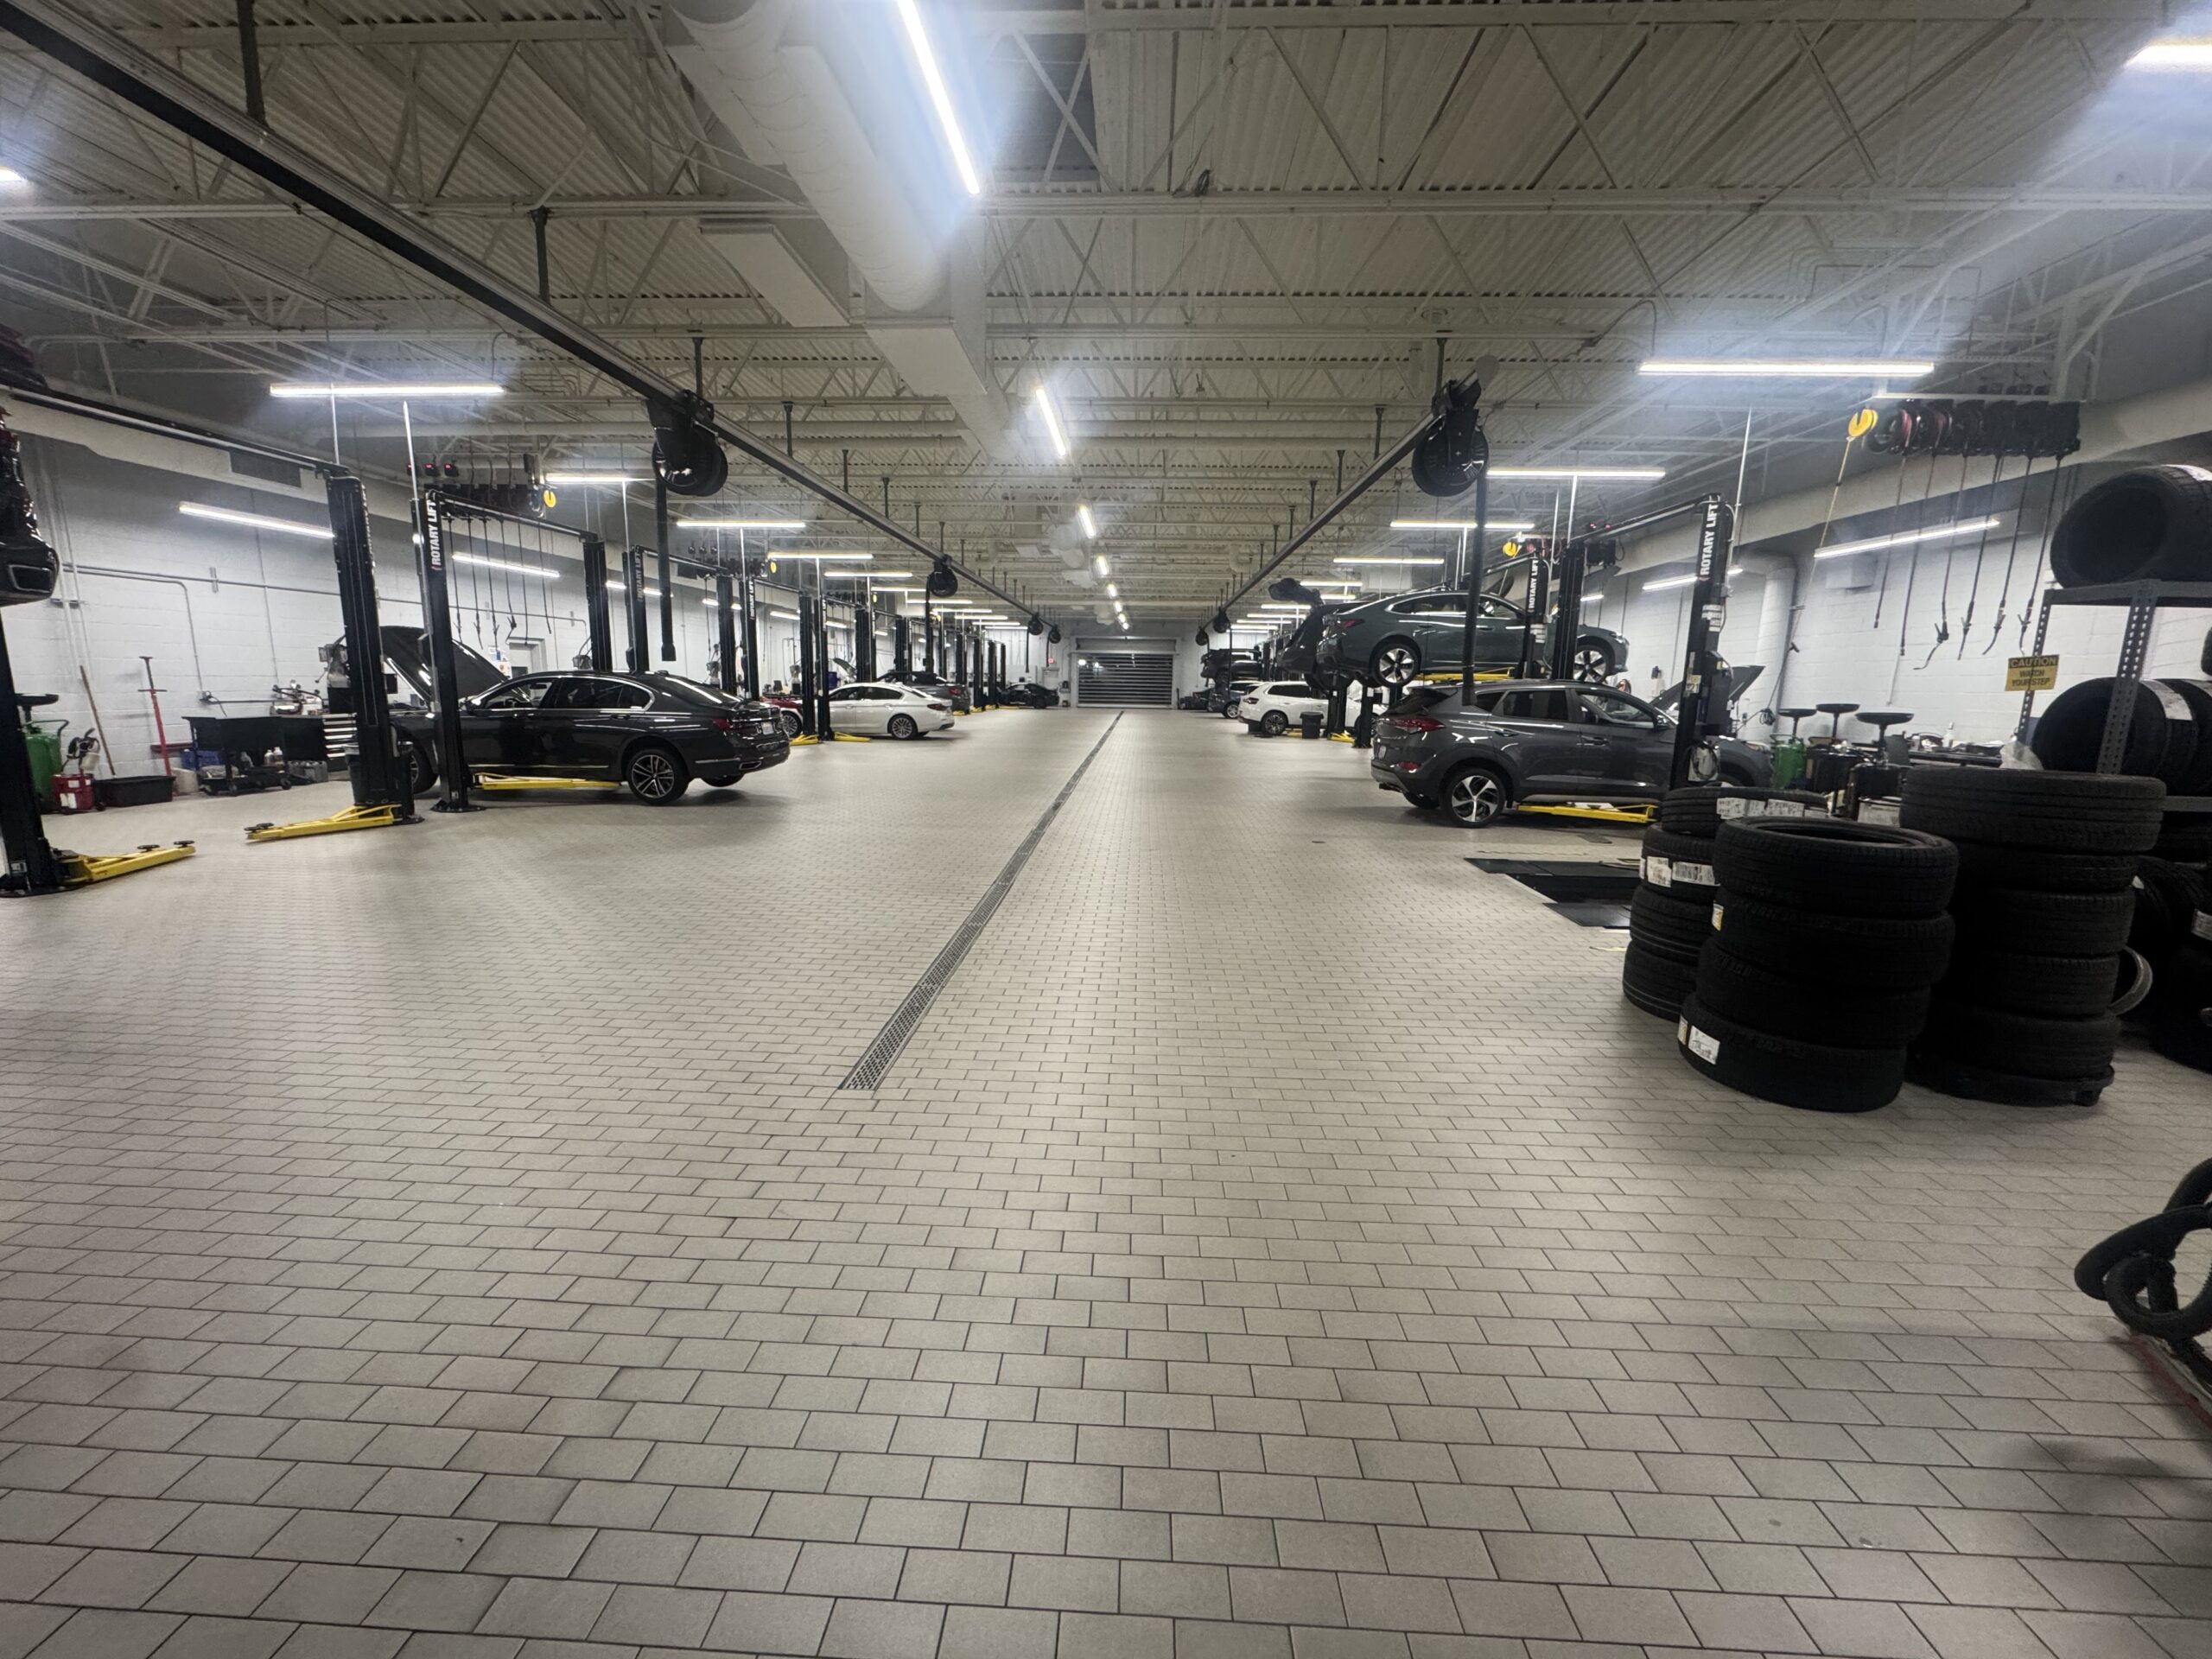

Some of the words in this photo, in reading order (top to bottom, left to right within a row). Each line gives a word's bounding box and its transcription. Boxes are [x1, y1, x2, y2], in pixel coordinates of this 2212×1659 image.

[426, 499, 437, 523] LIFT
[1706, 504, 1719, 528] LIFT
[429, 524, 442, 565] ROTARY
[1700, 531, 1714, 575] ROTARY
[1529, 578, 1537, 608] ROTARY
[2011, 657, 2056, 668] CAUTION
[2019, 670, 2045, 678] WATCH
